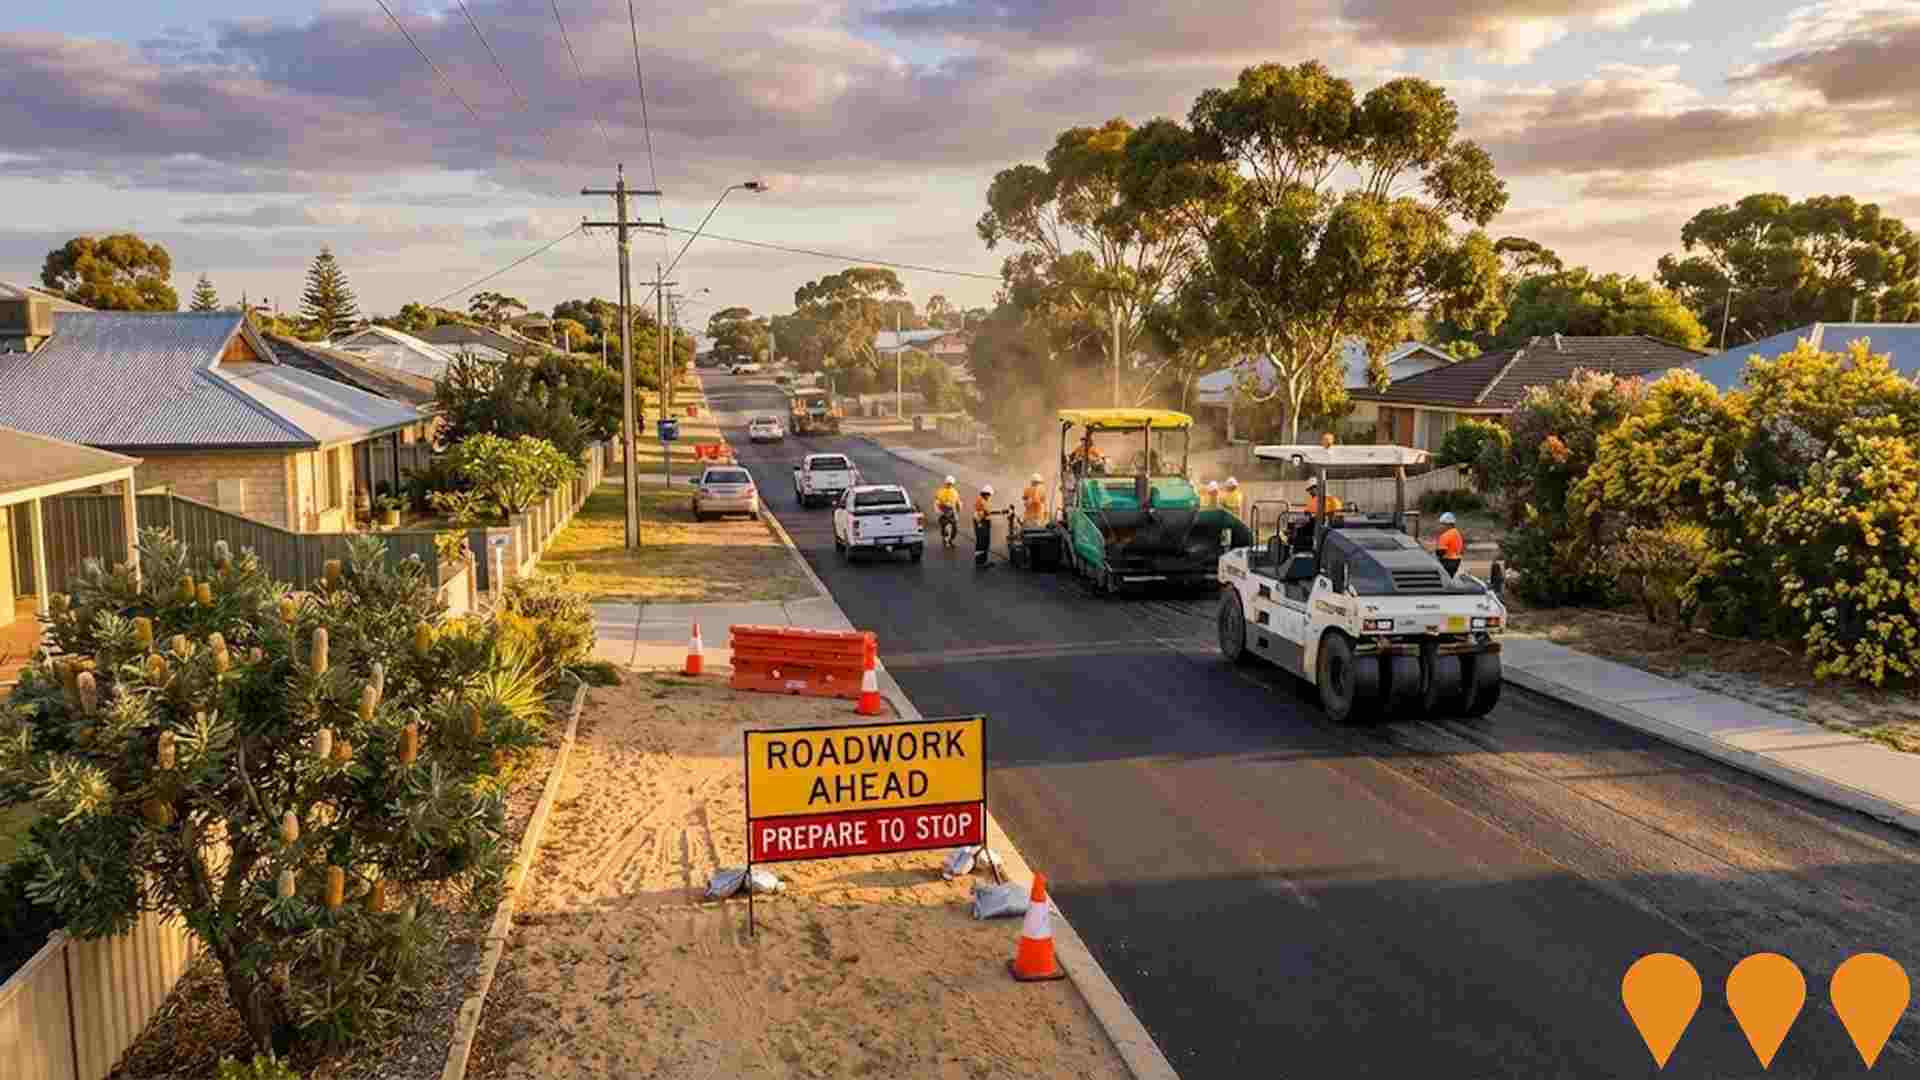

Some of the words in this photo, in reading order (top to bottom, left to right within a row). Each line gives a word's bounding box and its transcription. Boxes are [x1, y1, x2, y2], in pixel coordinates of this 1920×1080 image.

[767, 730, 966, 769] ROADWORK
[808, 770, 929, 804] AHEAD
[762, 821, 867, 853] PREPARE
[878, 818, 905, 843] TO
[916, 813, 972, 839] STOP
